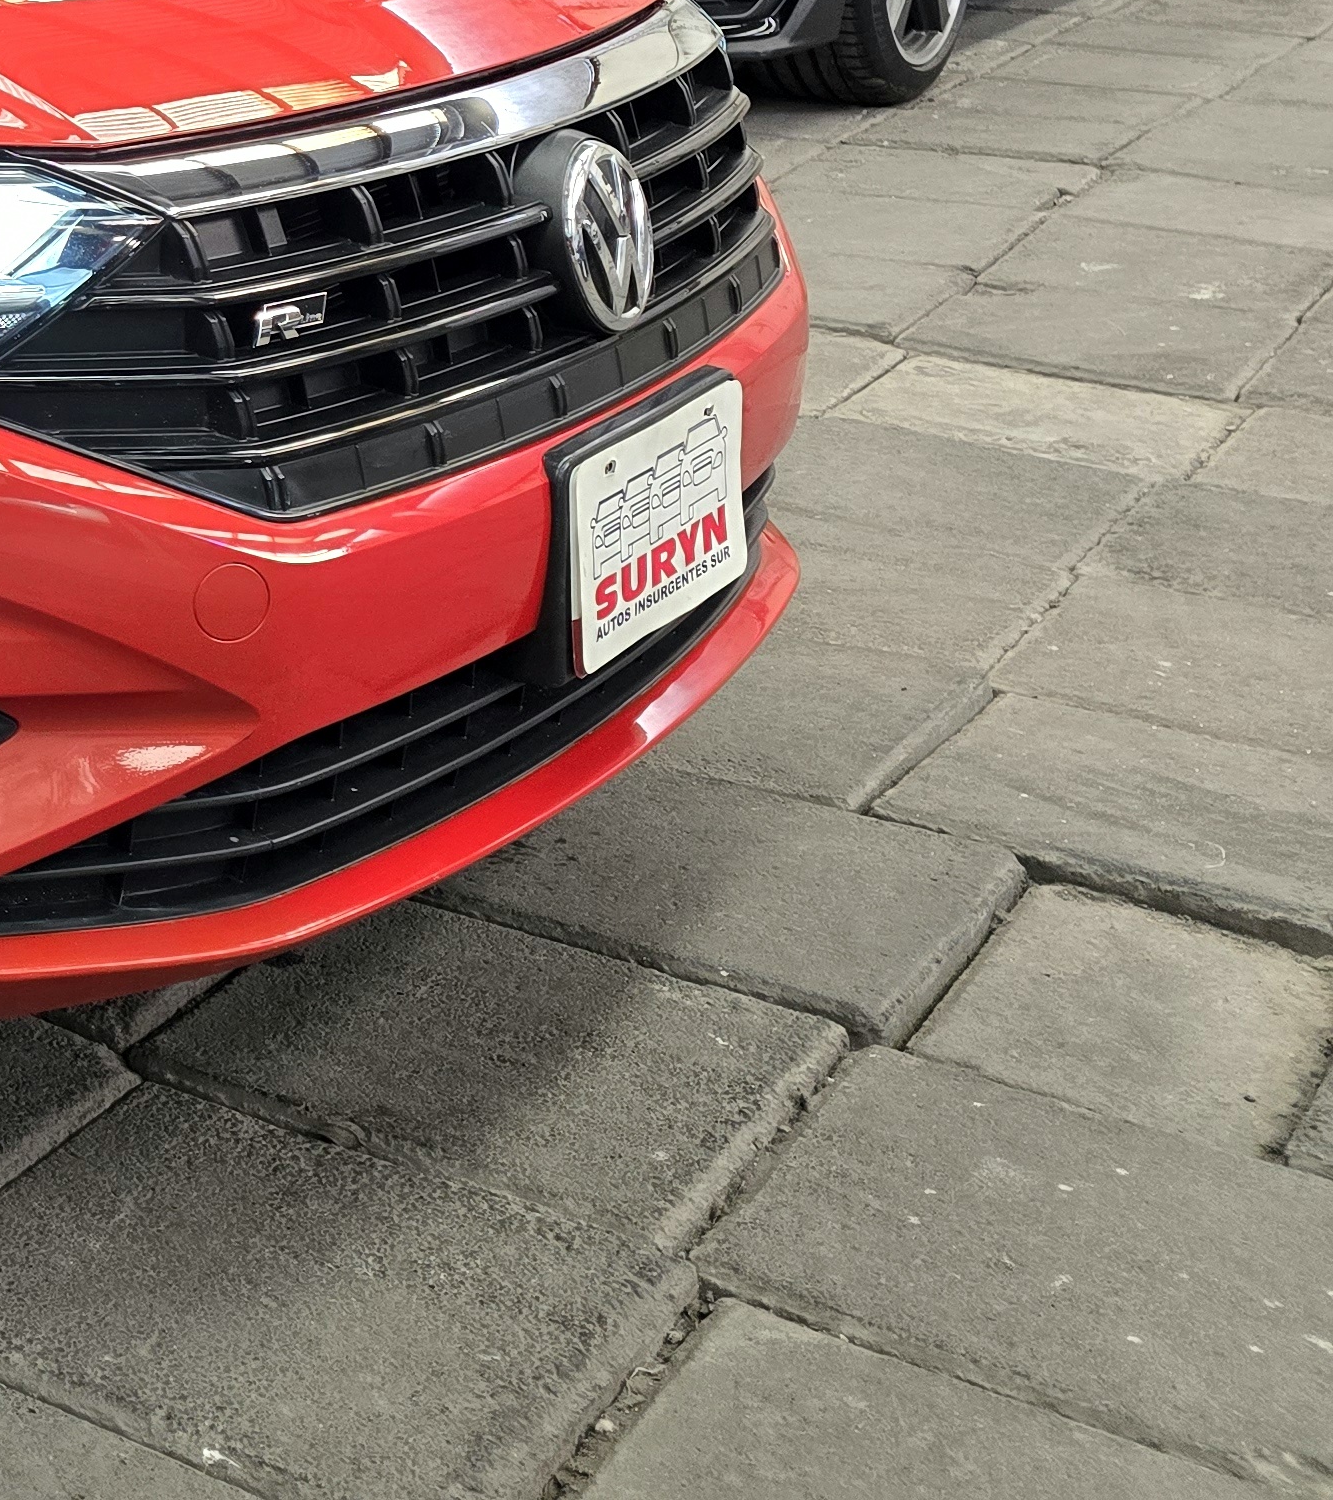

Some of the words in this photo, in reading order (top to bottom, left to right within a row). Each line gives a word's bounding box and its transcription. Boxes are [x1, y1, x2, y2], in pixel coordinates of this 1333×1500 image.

[595, 503, 728, 621] SURYN
[596, 606, 632, 643] AUTOS
[634, 559, 709, 617] INSURGENTES
[710, 545, 731, 569] SUR
